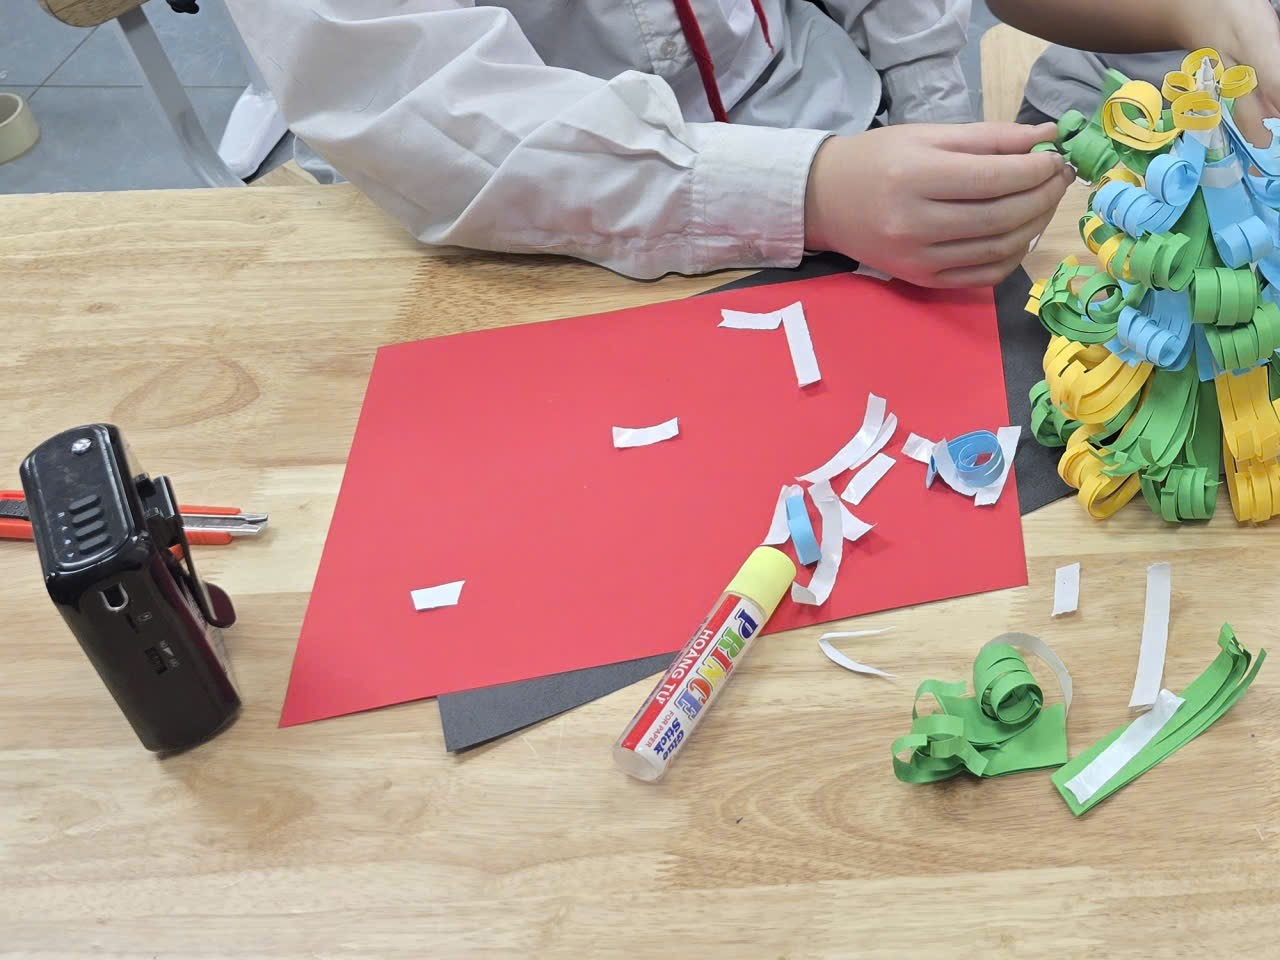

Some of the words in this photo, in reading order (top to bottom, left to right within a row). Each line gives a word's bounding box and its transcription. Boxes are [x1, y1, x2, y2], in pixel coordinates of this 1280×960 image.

[674, 608, 758, 720] PRINCE
[662, 711, 675, 726] FOR
[646, 724, 664, 748] PAPER
[654, 717, 681, 755] Stick
[663, 730, 684, 760] Glue
